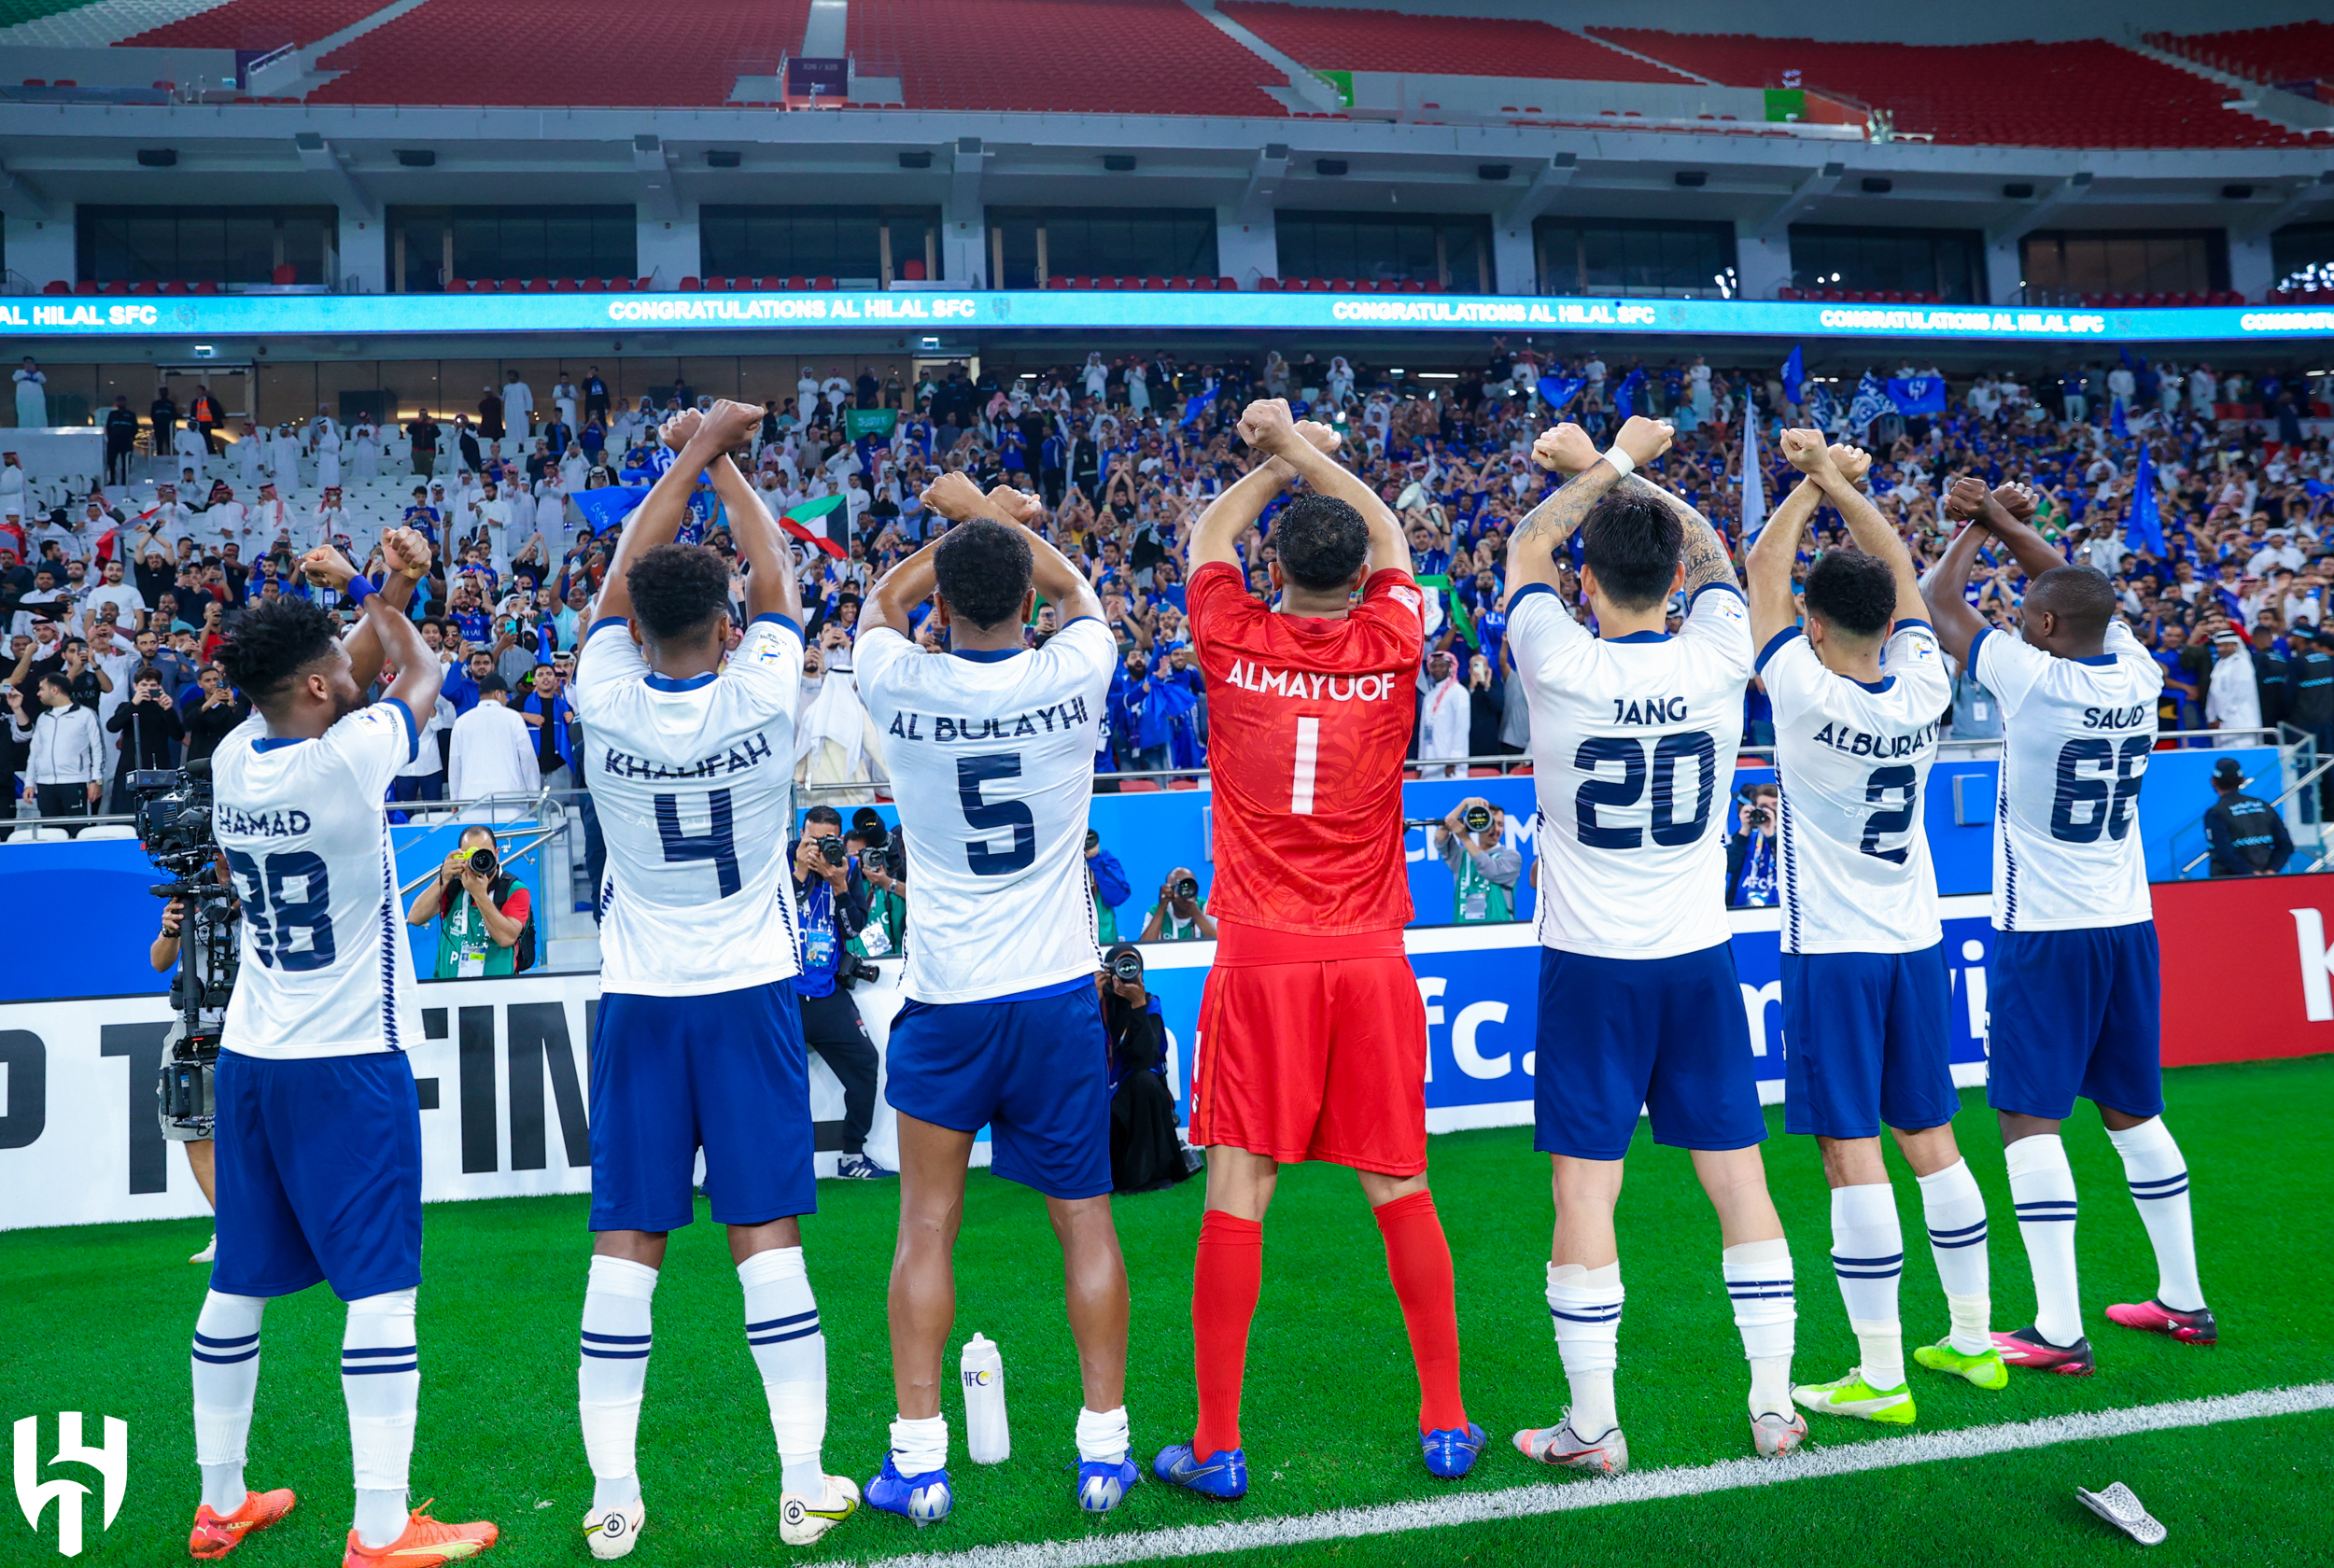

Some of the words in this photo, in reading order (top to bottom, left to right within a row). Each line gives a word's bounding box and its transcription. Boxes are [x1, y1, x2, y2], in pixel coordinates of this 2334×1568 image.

[0, 306, 28, 325] AL
[34, 305, 105, 325] HILAL
[109, 305, 157, 325] SFC
[609, 301, 826, 320] CONGRATULATIONS
[830, 301, 860, 318] AL
[865, 300, 928, 318] HILAL
[932, 299, 976, 318] SFC
[1332, 301, 1526, 322] CONGRATULATIONS
[1528, 304, 1556, 322] AL
[1558, 304, 1614, 324] HILAL
[1617, 306, 1655, 324] SFC
[1821, 310, 1990, 330] CONGRATULATIONS
[1992, 314, 2017, 331] AL
[2018, 315, 2069, 332] HILAL
[2070, 315, 2104, 333] SFC
[1225, 658, 1395, 702] ALMAYUOF
[889, 710, 923, 741] AL
[935, 695, 1089, 742] BULAYHI
[1613, 696, 1687, 725] JANG
[2083, 705, 2144, 730] SAUD
[605, 732, 772, 780] KHALIFAH
[1291, 716, 1319, 815] 1
[1573, 731, 1716, 849] 20
[2050, 735, 2152, 844] 66
[218, 804, 311, 837] HAMAD
[956, 752, 1036, 876] 5
[1860, 764, 1917, 864] 2
[654, 788, 741, 899] 4
